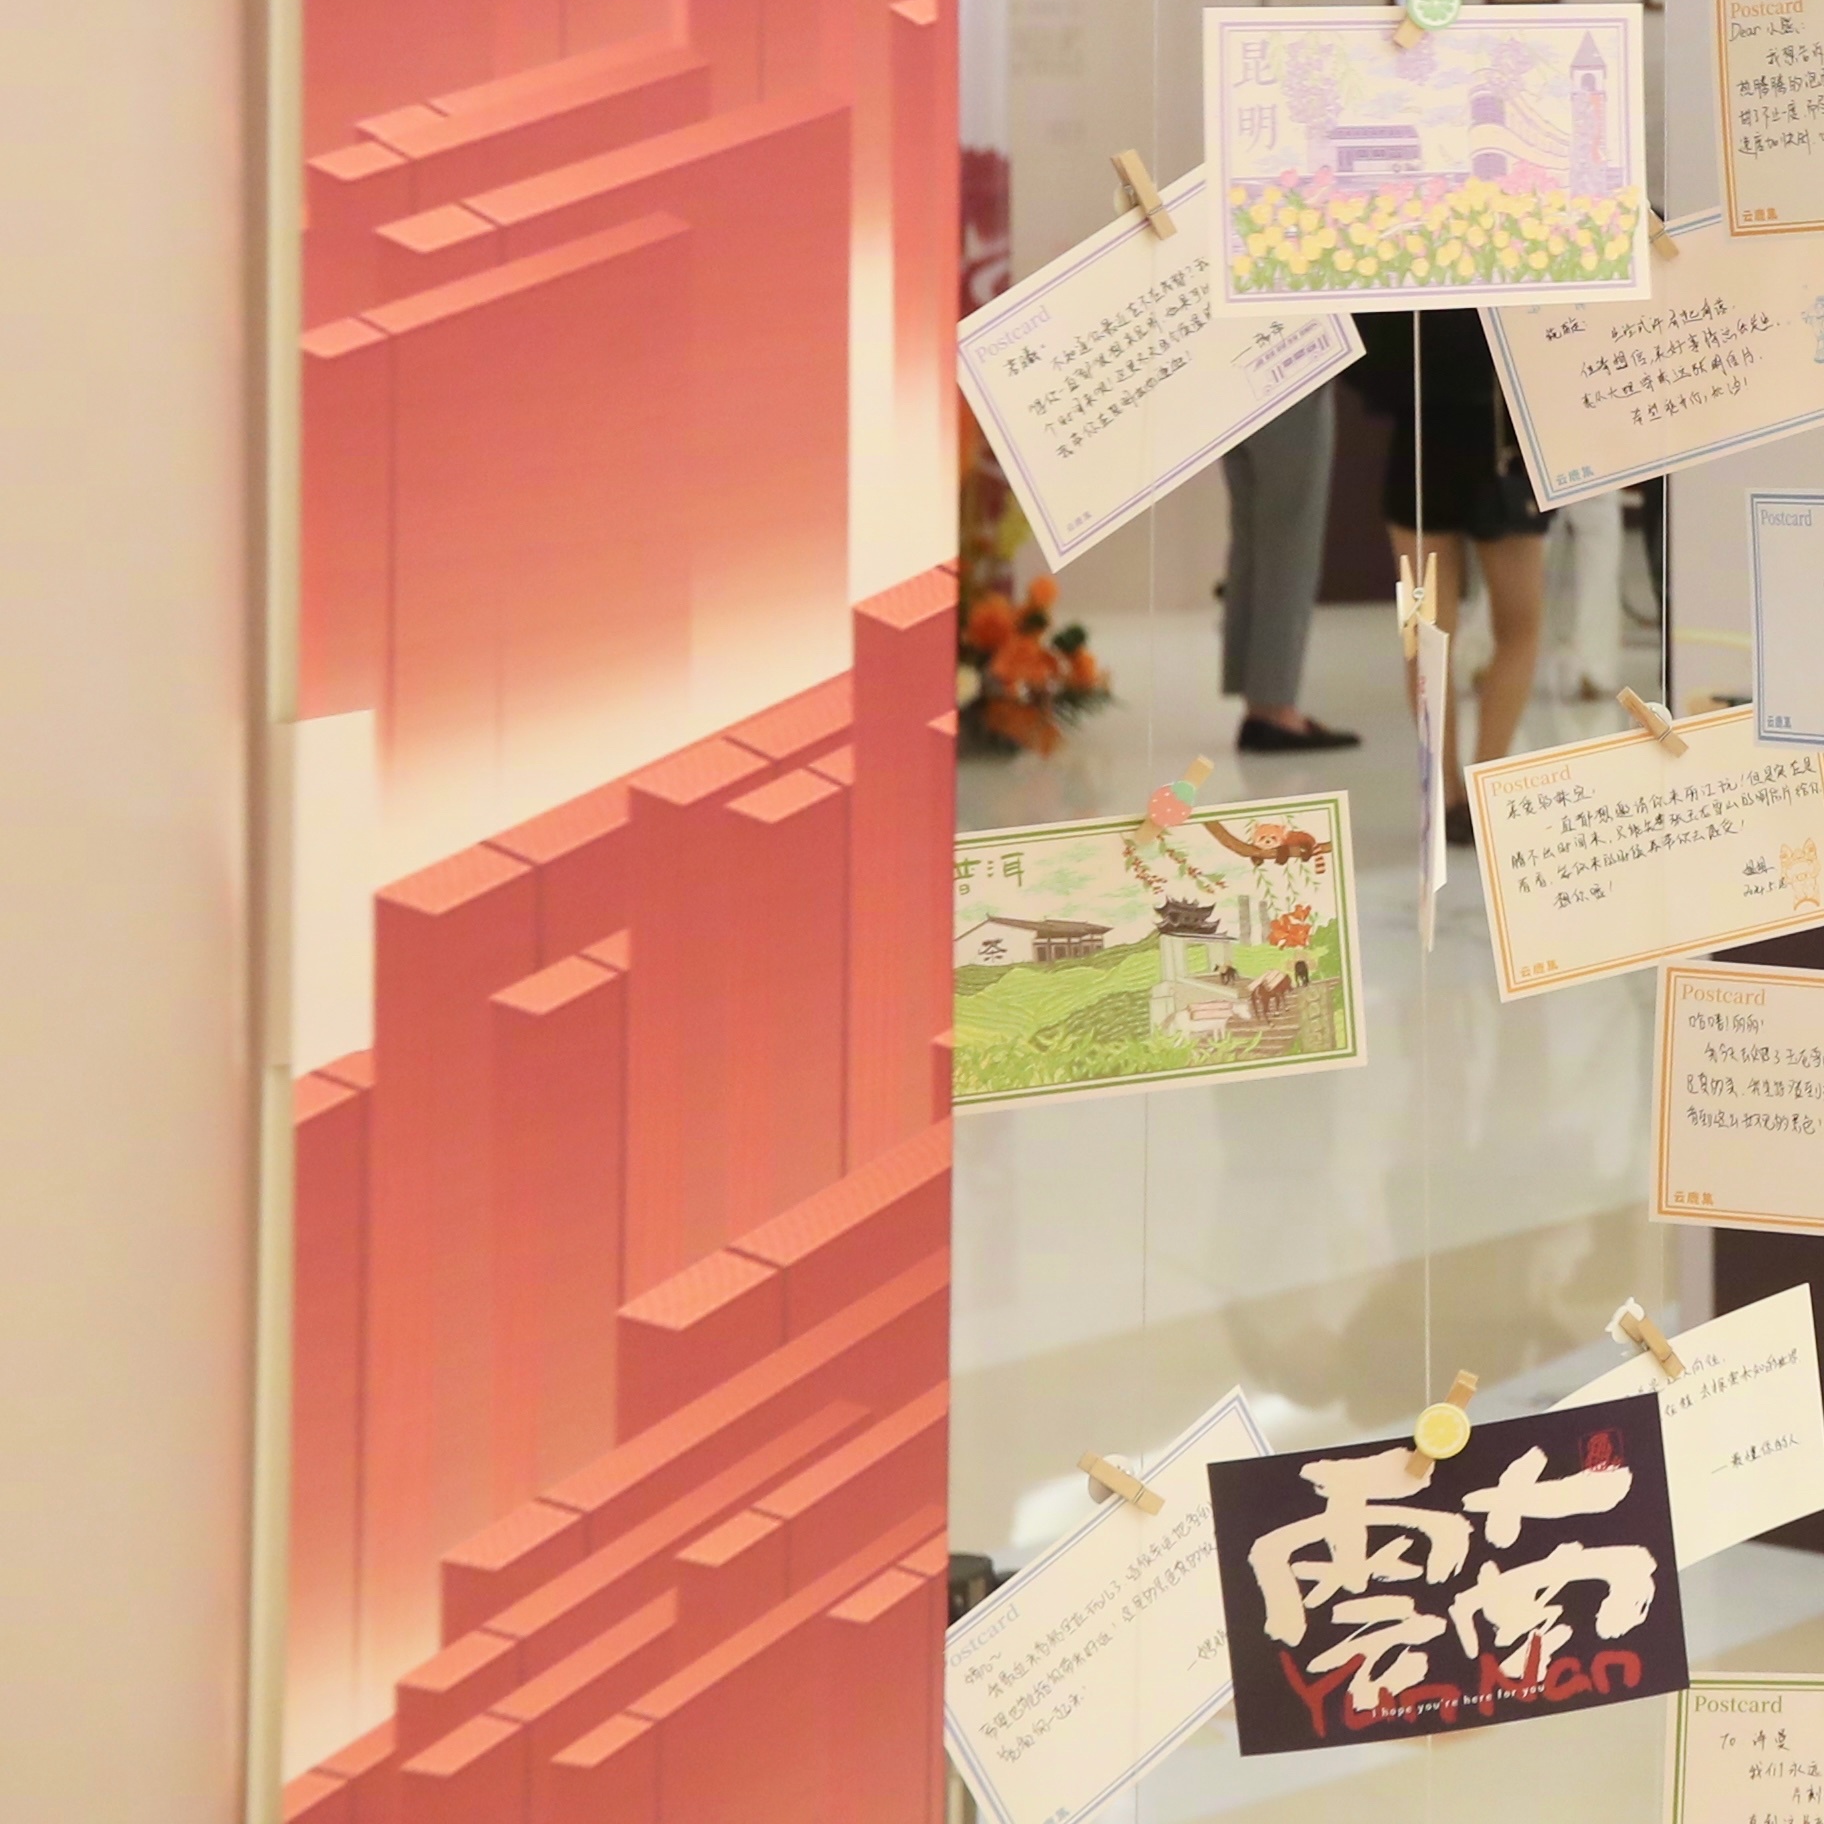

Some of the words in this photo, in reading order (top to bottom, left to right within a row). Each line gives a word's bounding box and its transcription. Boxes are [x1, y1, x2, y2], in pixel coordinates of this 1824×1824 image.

[1730, 21, 1761, 43] Dear
[1233, 39, 1278, 153] 昆明
[974, 305, 1052, 364] Postcard
[1760, 509, 1813, 527] Postcard
[1490, 765, 1573, 797] Postcard
[954, 852, 1025, 896] 普洱
[978, 938, 1007, 963] 茶
[1681, 983, 1767, 1007] Postcard
[949, 1603, 1021, 1669] ostcard
[1381, 1705, 1413, 1719] hope
[1417, 1698, 1459, 1716] you're
[1463, 1691, 1493, 1706] here
[1496, 1686, 1517, 1700] for
[1521, 1683, 1546, 1698] you
[1695, 1695, 1783, 1717] Postcard
